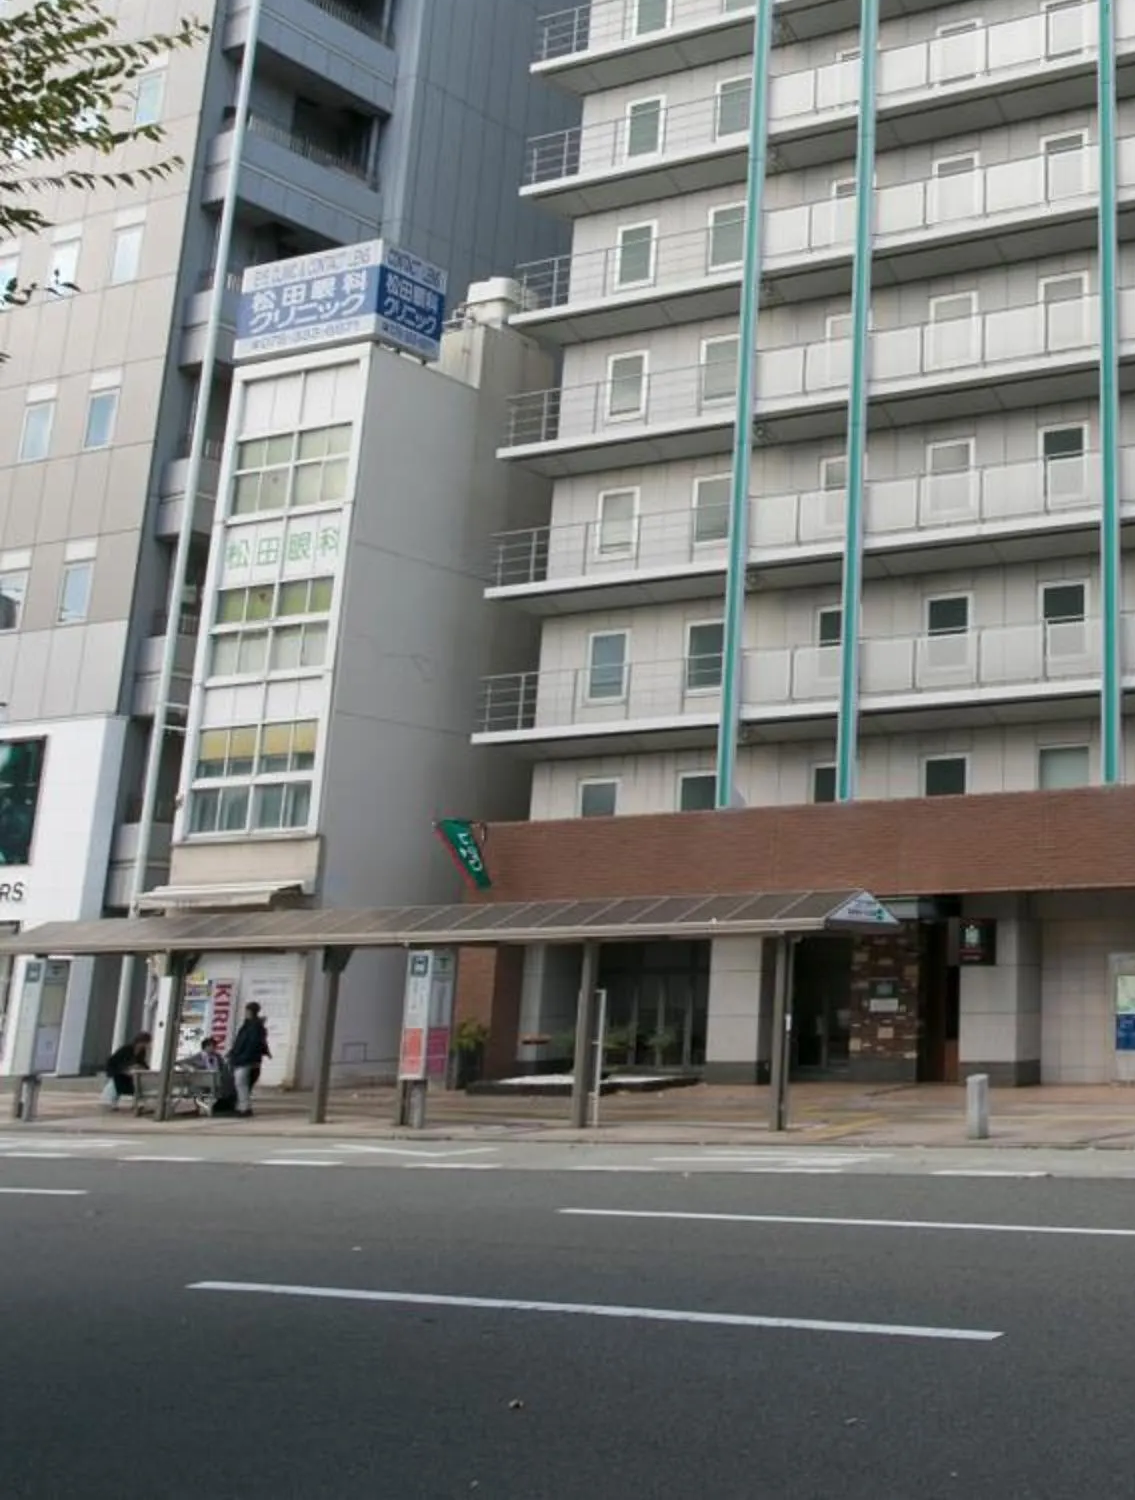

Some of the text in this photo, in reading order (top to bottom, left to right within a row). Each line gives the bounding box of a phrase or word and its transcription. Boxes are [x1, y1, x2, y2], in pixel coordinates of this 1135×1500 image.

[253, 268, 367, 313] 松田眼科
[249, 294, 365, 334] クリニック
[383, 296, 437, 334] クリニック
[226, 526, 340, 570] 松田眼科
[212, 984, 233, 1051] KIRIN
